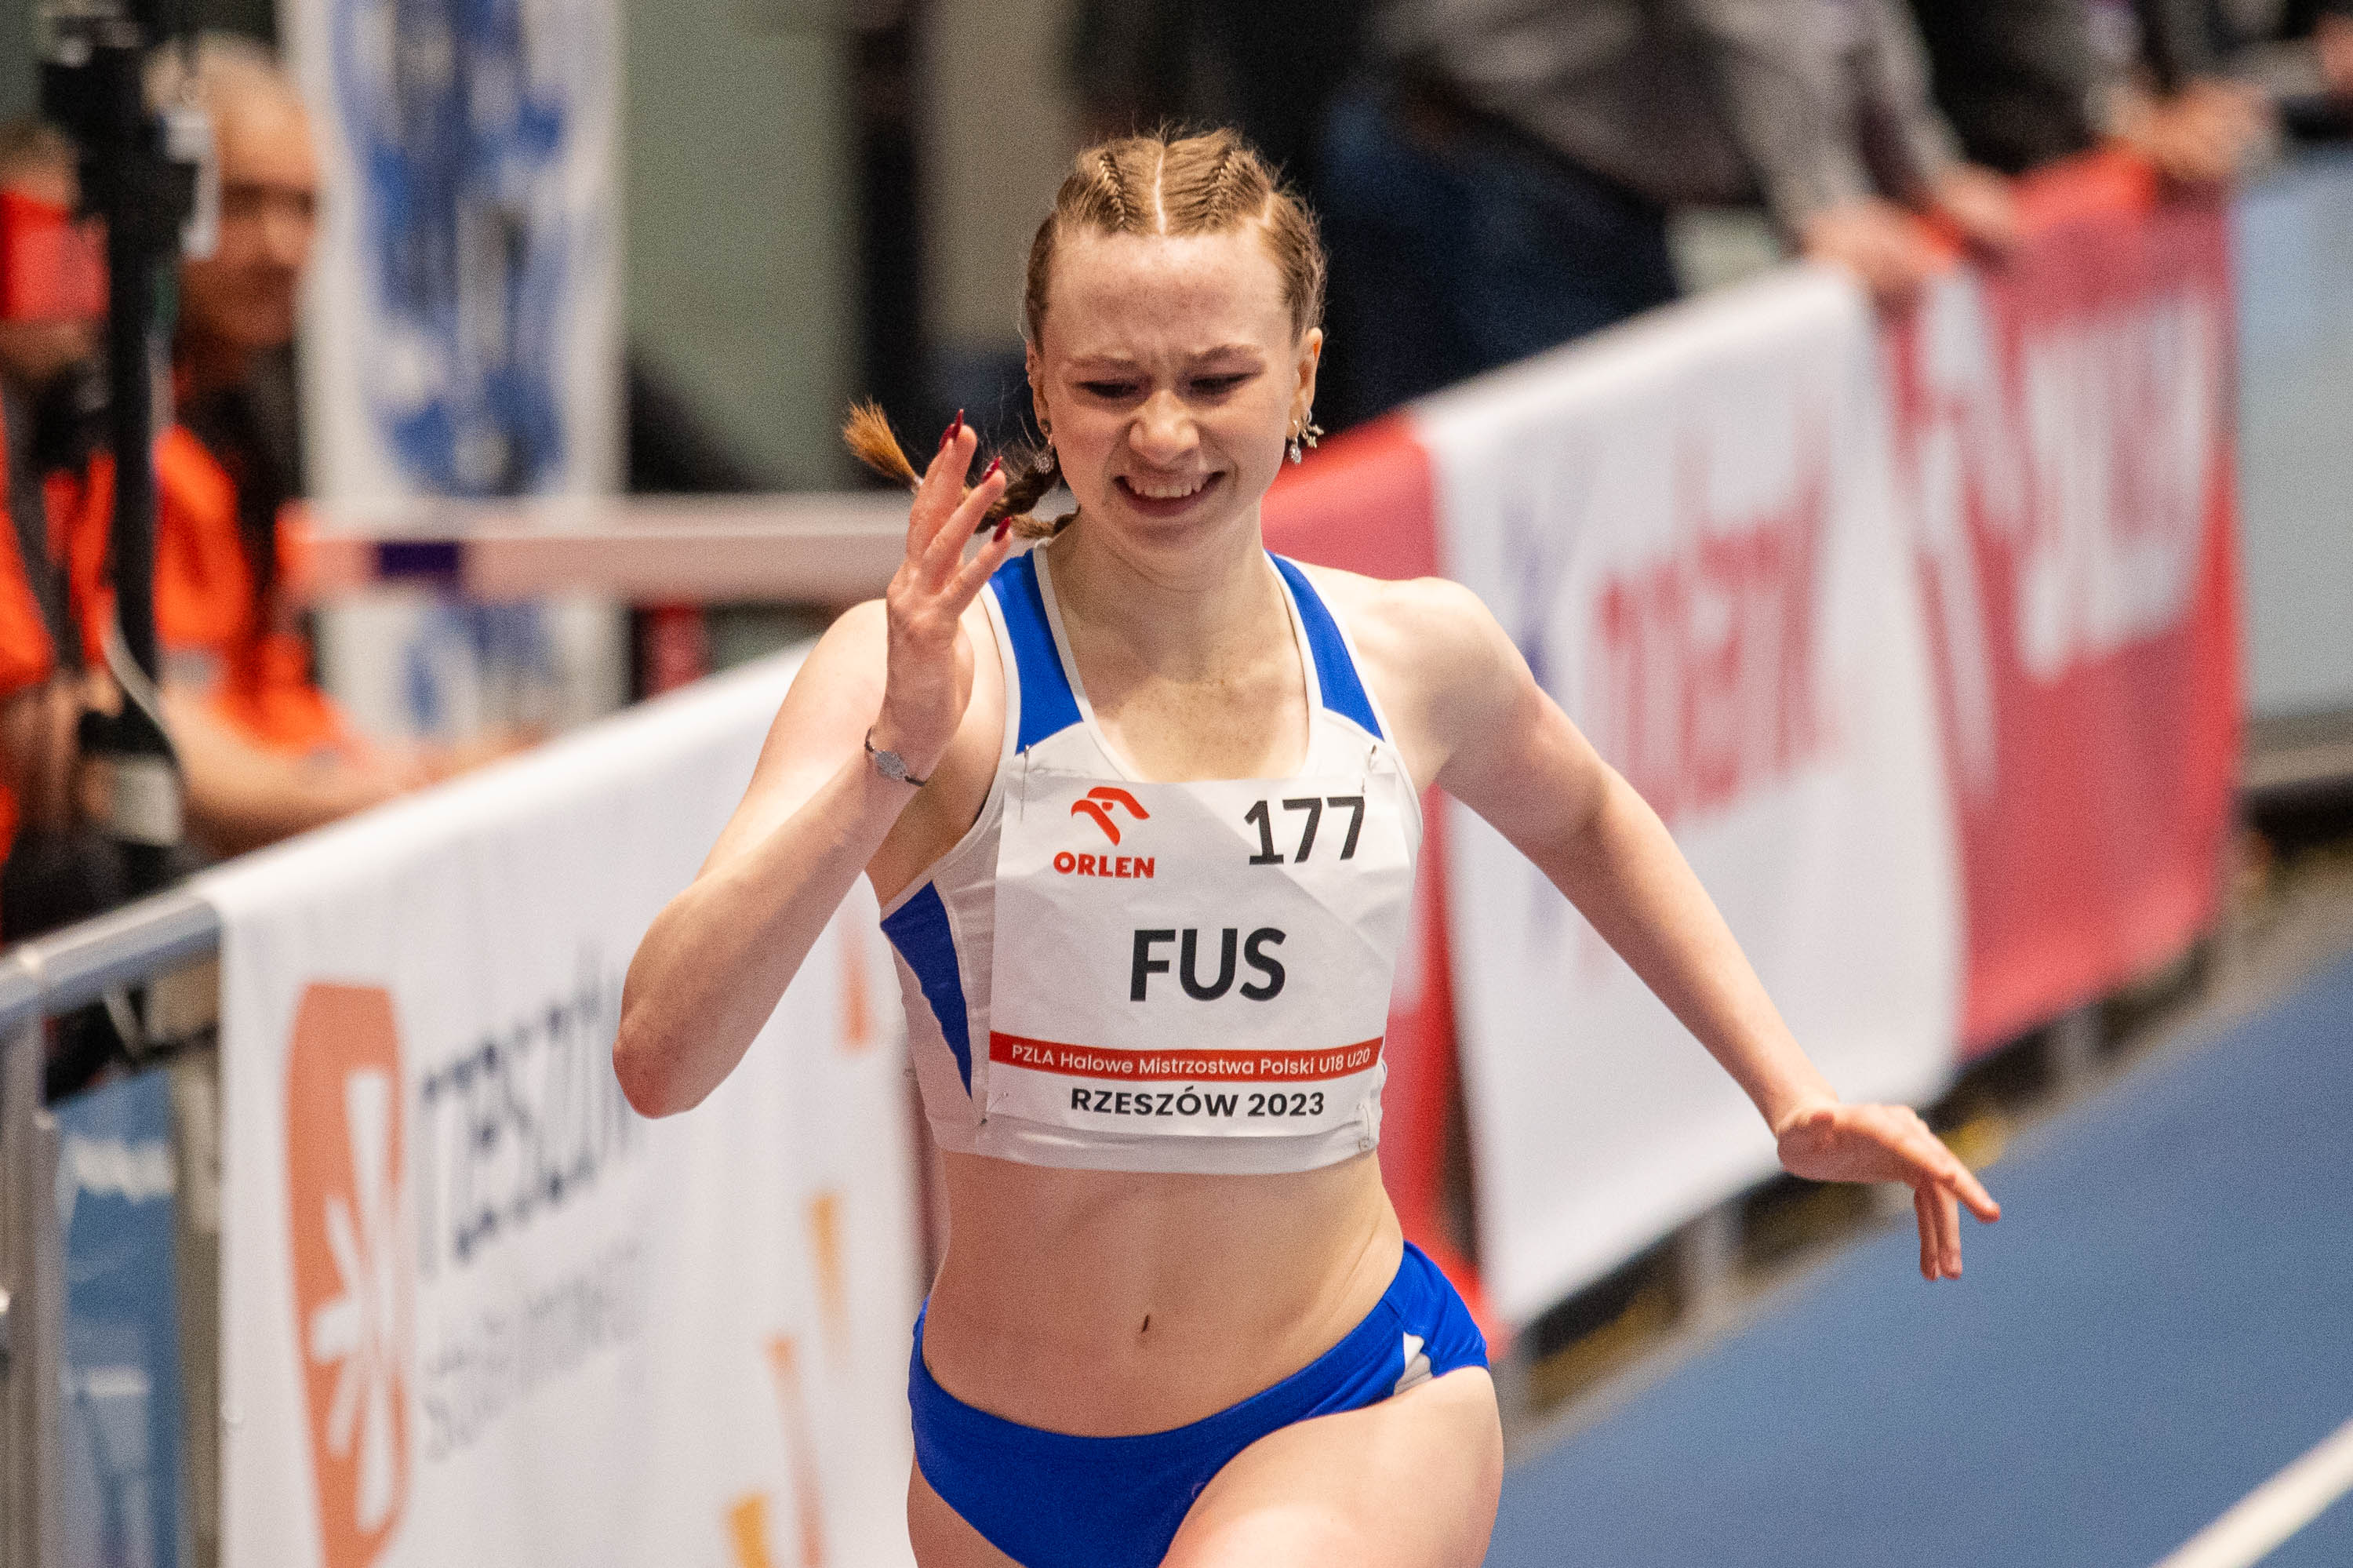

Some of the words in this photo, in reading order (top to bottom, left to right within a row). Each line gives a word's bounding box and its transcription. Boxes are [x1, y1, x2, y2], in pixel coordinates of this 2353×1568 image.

[1244, 795, 1365, 865] 177
[1053, 851, 1155, 879] ORLEN
[1130, 927, 1286, 1002] FUS
[1012, 1044, 1054, 1065] PZLA
[1060, 1053, 1133, 1073] Halowe
[1139, 1057, 1254, 1075] Mistrzostwa
[1260, 1057, 1315, 1075] Polski
[1319, 1055, 1344, 1073] U18
[1347, 1047, 1371, 1068] U20
[1071, 1086, 1238, 1117] RZESZÓW
[1247, 1092, 1325, 1116] 2023
